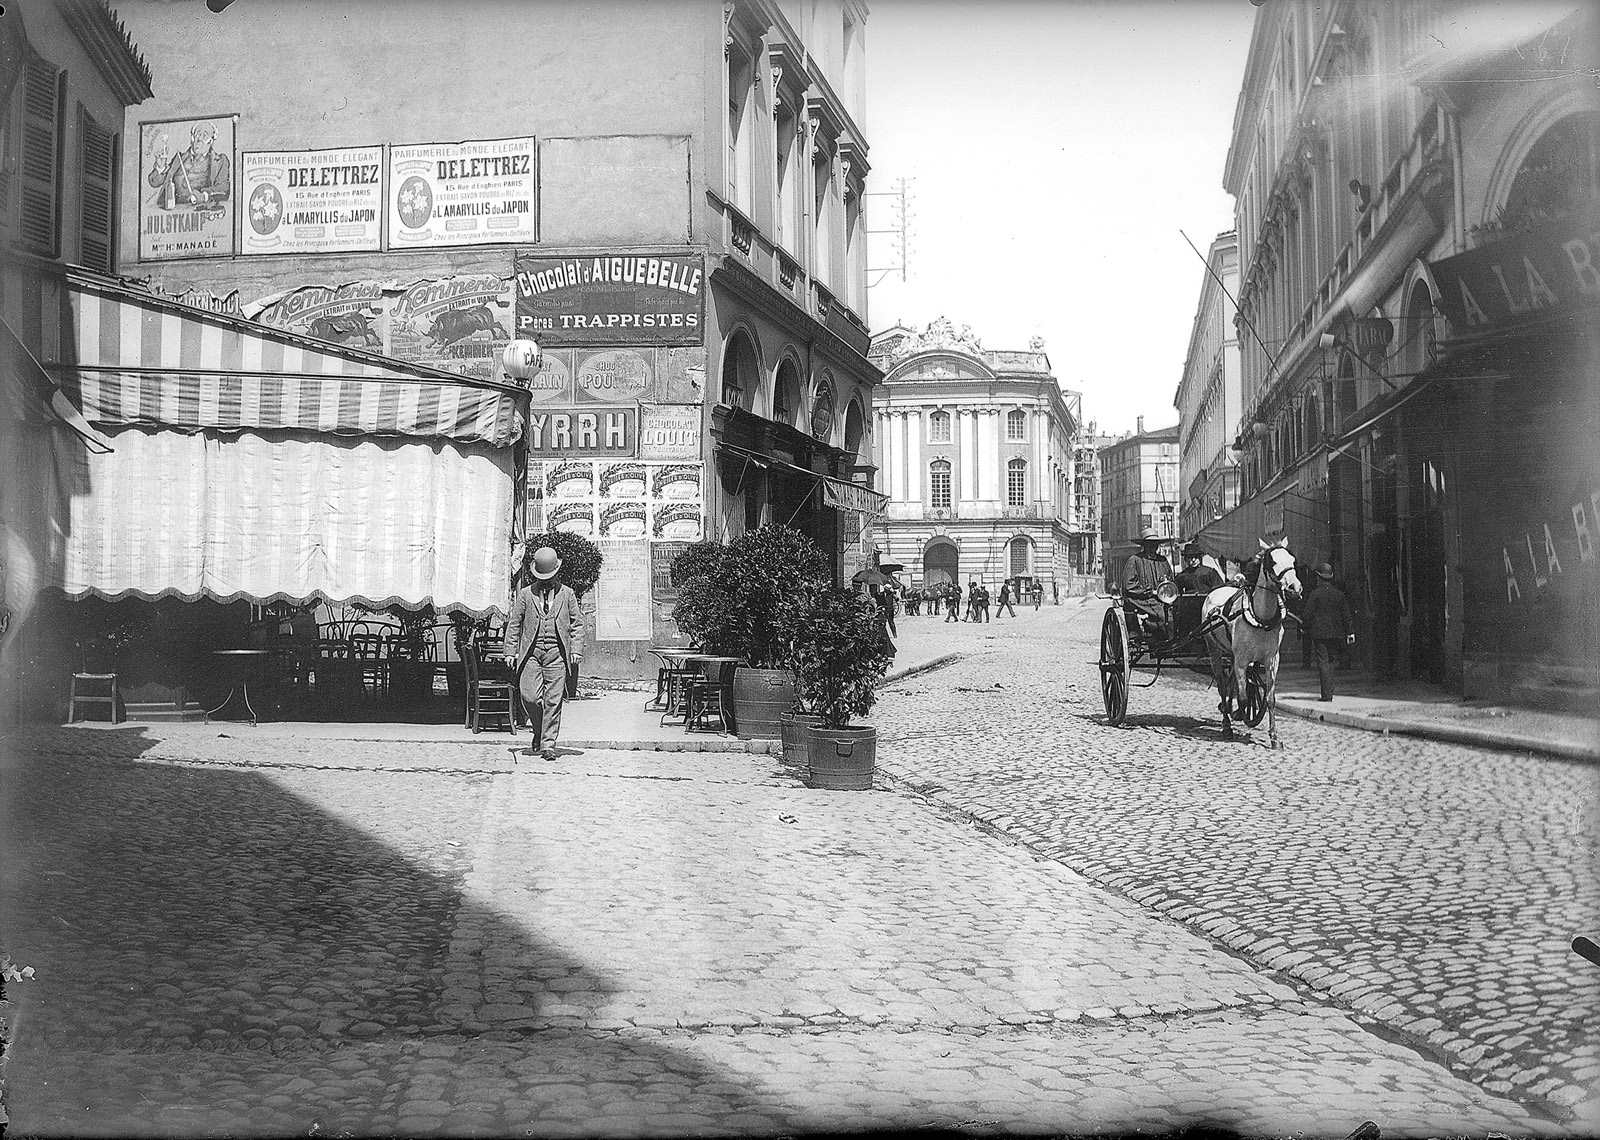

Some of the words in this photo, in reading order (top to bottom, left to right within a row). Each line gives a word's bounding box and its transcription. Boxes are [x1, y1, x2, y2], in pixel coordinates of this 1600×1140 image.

[248, 155, 301, 165] PARFUMERIE
[311, 154, 338, 164] MONDE
[395, 148, 450, 158] PARFUMERIE
[460, 145, 489, 155] MONDE
[288, 164, 379, 188] DELETTREZ
[437, 155, 530, 180] DELETTREZ
[307, 191, 319, 199] Rue
[351, 189, 371, 197] PARIS
[286, 210, 339, 225] L'AMARYLLIS
[348, 208, 376, 222] JAPON
[437, 201, 490, 218] L'AMARYLLIS
[501, 200, 529, 214] JAPON
[517, 259, 582, 298] Chocolat
[592, 257, 702, 296] AIGUEBELLE
[1459, 275, 1489, 326] A
[1491, 256, 1559, 314] LA
[323, 303, 345, 317] EXTRAIT
[449, 299, 471, 312] EXTRAIT
[559, 313, 699, 329] TRAPPISTES
[648, 418, 694, 430] CHOCOLAT
[644, 430, 697, 447] LOUIT
[1503, 546, 1520, 603] A
[1526, 523, 1561, 588] LA
